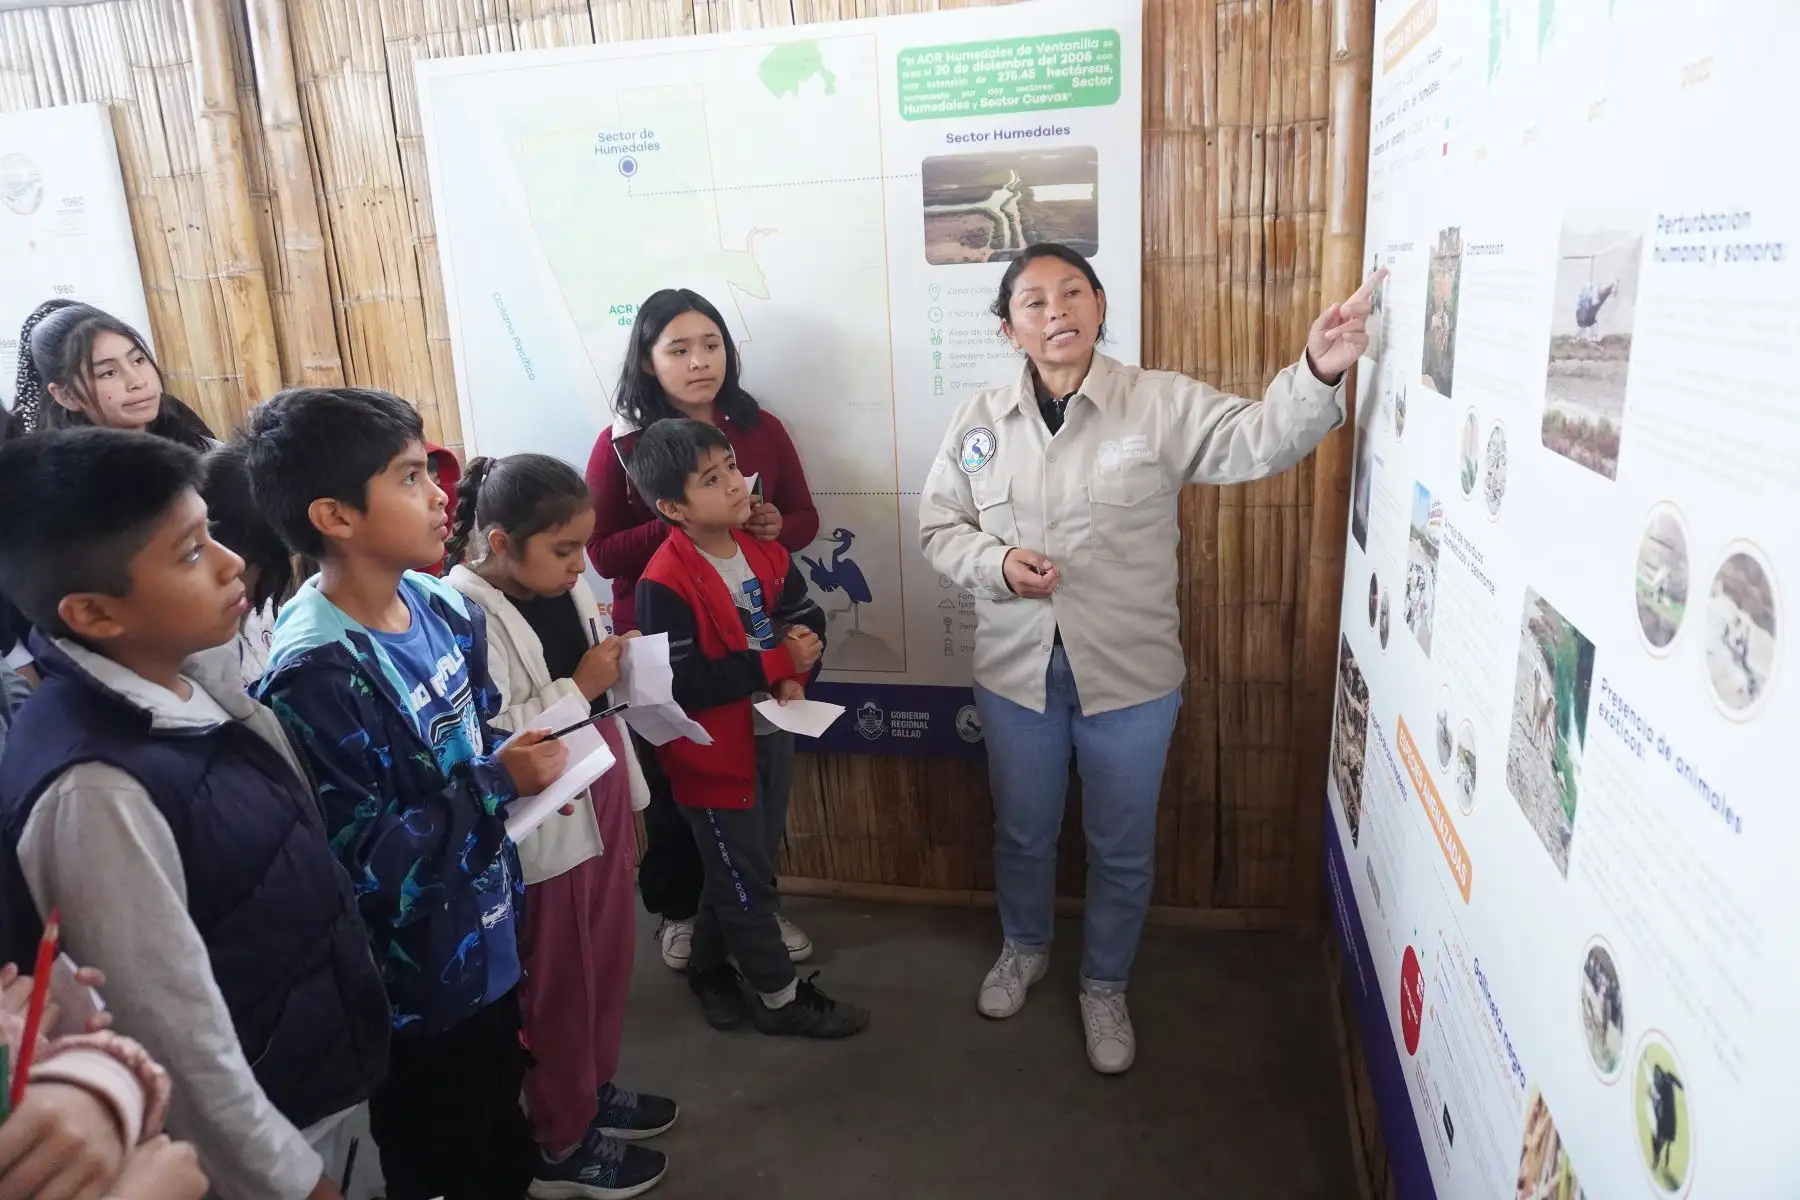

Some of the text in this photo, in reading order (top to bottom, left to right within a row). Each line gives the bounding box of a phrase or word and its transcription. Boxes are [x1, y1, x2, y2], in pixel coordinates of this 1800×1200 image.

[916, 52, 942, 65] ACR
[946, 46, 1013, 62] Humedales
[1016, 44, 1032, 56] de
[1036, 38, 1099, 53] Ventanilla
[935, 64, 950, 76] 20
[954, 62, 969, 74] de
[972, 57, 1035, 73] diciembre
[1038, 53, 1056, 66] del
[1060, 51, 1093, 64] 2006
[962, 90, 976, 98] por
[1071, 76, 1114, 88] Sector
[904, 99, 970, 115] Humedales
[971, 101, 978, 110] y
[980, 95, 1020, 109] Sector
[598, 127, 655, 143] Sector de
[946, 124, 1071, 144] Sector Humedales
[594, 140, 661, 156] Humedales
[609, 304, 633, 314] ACR
[618, 316, 632, 326] de
[890, 711, 930, 721] GOBIERNO
[891, 720, 929, 729] REGIONAL
[891, 728, 921, 738] CALLAO
[1600, 676, 1743, 835] Presencia de animales
